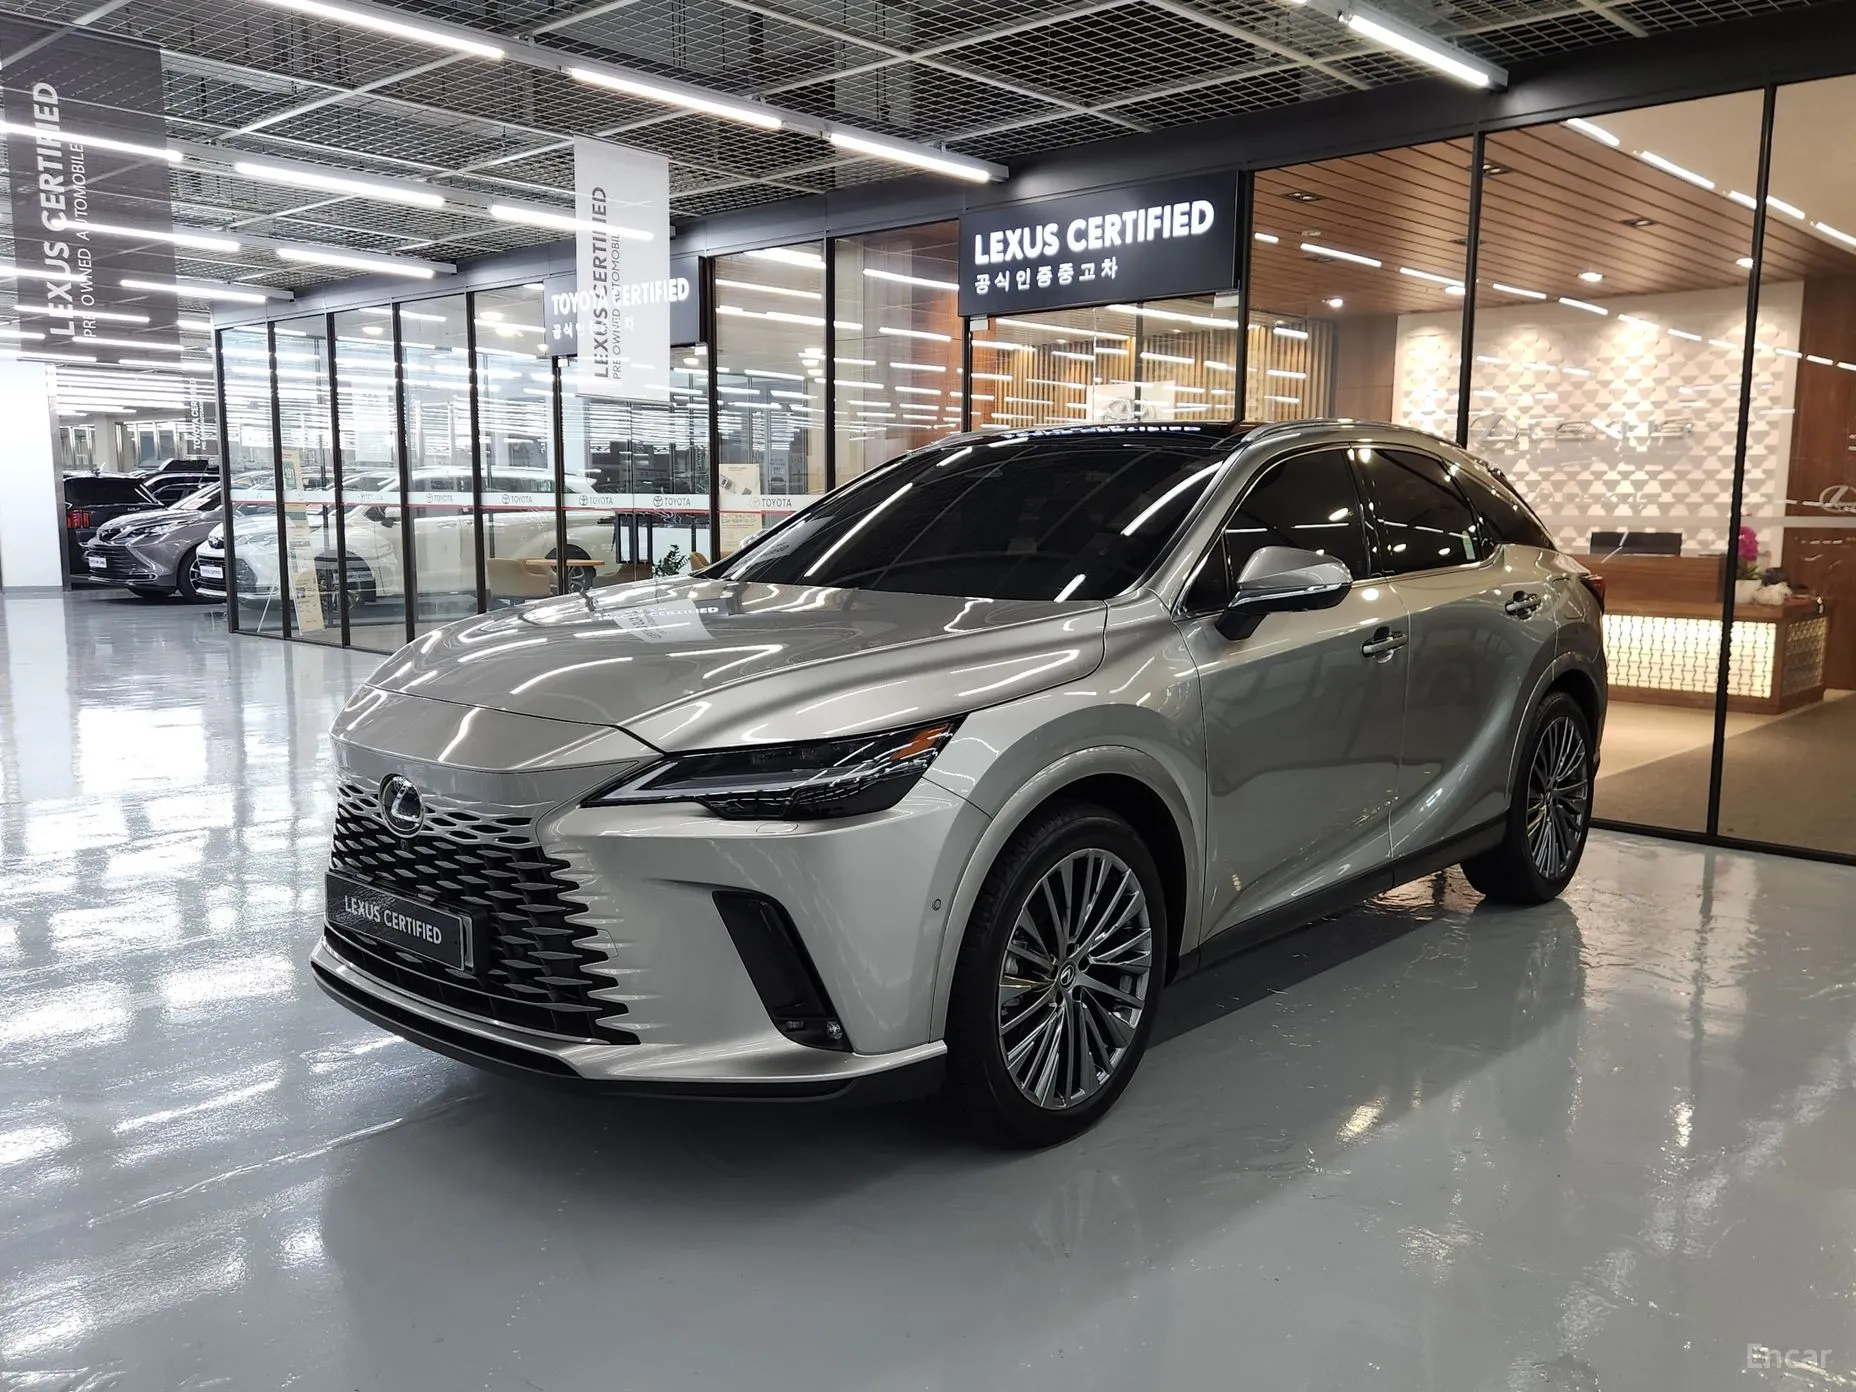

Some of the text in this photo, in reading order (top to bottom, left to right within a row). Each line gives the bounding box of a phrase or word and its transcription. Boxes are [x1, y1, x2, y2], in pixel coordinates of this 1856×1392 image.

[974, 199, 1216, 265] LEXUS CERTIFIED
[44, 241, 75, 335] LEXUS
[78, 248, 95, 306] OWNED
[593, 308, 608, 378] LEXUS
[613, 358, 621, 379] PRE
[510, 495, 533, 504] TOYOTA
[589, 496, 614, 505] TOYOTA
[664, 497, 691, 507] TOYOTA
[761, 498, 792, 508] TOYOTA
[344, 895, 442, 945] LEXUS CERTIFIED
